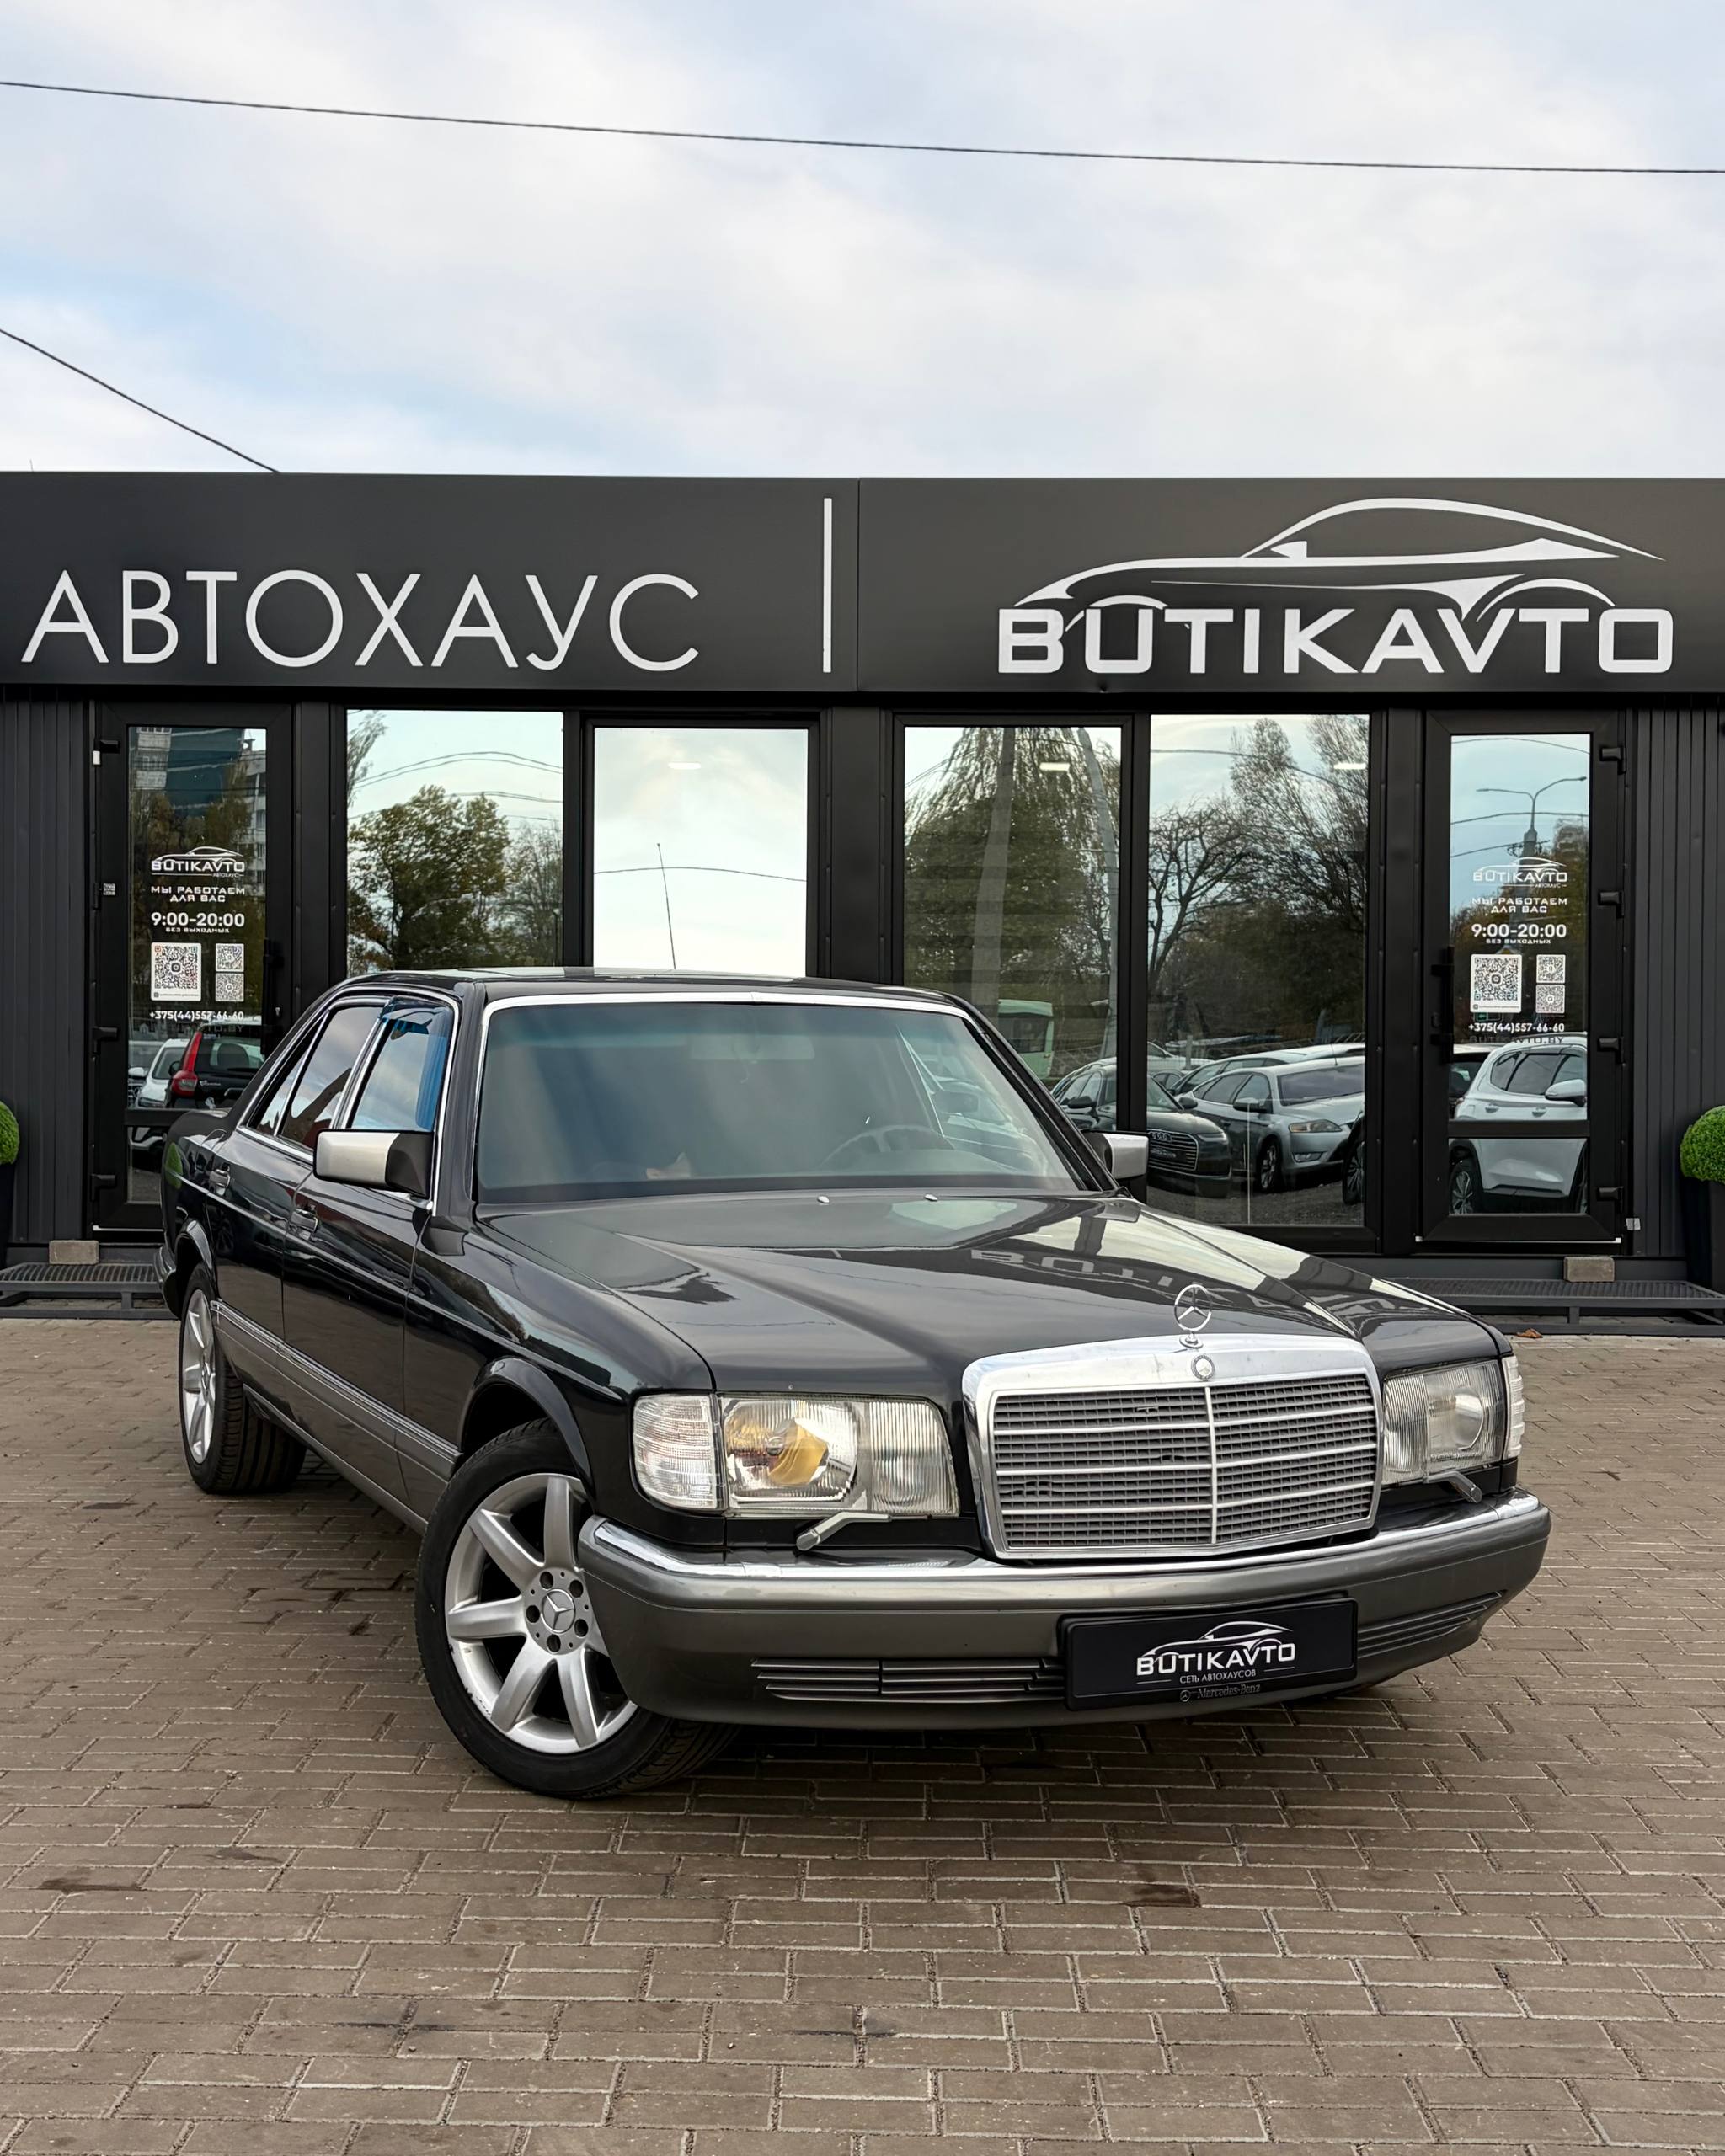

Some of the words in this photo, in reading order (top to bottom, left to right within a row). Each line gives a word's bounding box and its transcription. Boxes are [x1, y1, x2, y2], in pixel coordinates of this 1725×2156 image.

[21, 569, 700, 672] АВТОХАУС
[998, 606, 1674, 674] BUTIKAVTO
[151, 860, 245, 872] BUTIKAVTO
[1472, 871, 1567, 882] BUTIKAVTO
[177, 886, 245, 894] РАБОТАЕМ
[1498, 897, 1567, 905] РАБОТАЕМ
[151, 911, 245, 927] 9:00-20:00
[1471, 923, 1567, 938] 9:00-20:00
[149, 1010, 244, 1022] +375(44)557-66-60
[1468, 1022, 1565, 1034] +375(44)557-66-60
[1136, 1643, 1295, 1676] BUTIKAVTO
[1179, 1674, 1199, 1684] СЕТЬ
[1201, 1669, 1257, 1682] АВТОХАУСОВ
[1197, 1684, 1261, 1699] Mercedes-Benz
